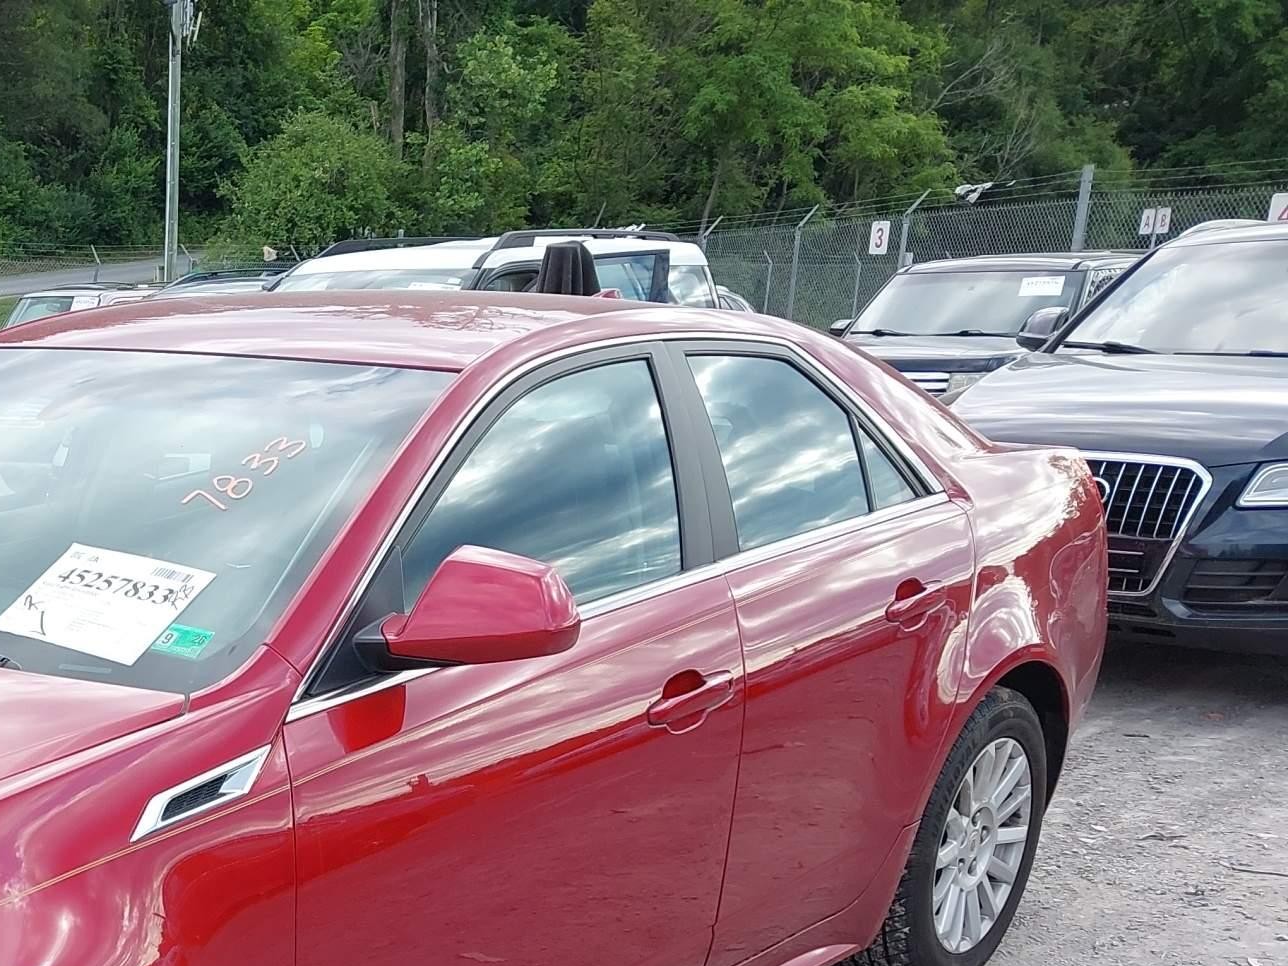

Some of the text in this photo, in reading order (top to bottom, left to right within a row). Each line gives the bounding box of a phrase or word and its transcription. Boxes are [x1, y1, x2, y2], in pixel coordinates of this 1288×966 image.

[1144, 214, 1150, 228] A
[1160, 213, 1167, 227] B
[875, 227, 884, 249] 3
[181, 436, 307, 511] 7833
[58, 567, 175, 605] 45257833
[161, 632, 174, 645] 9
